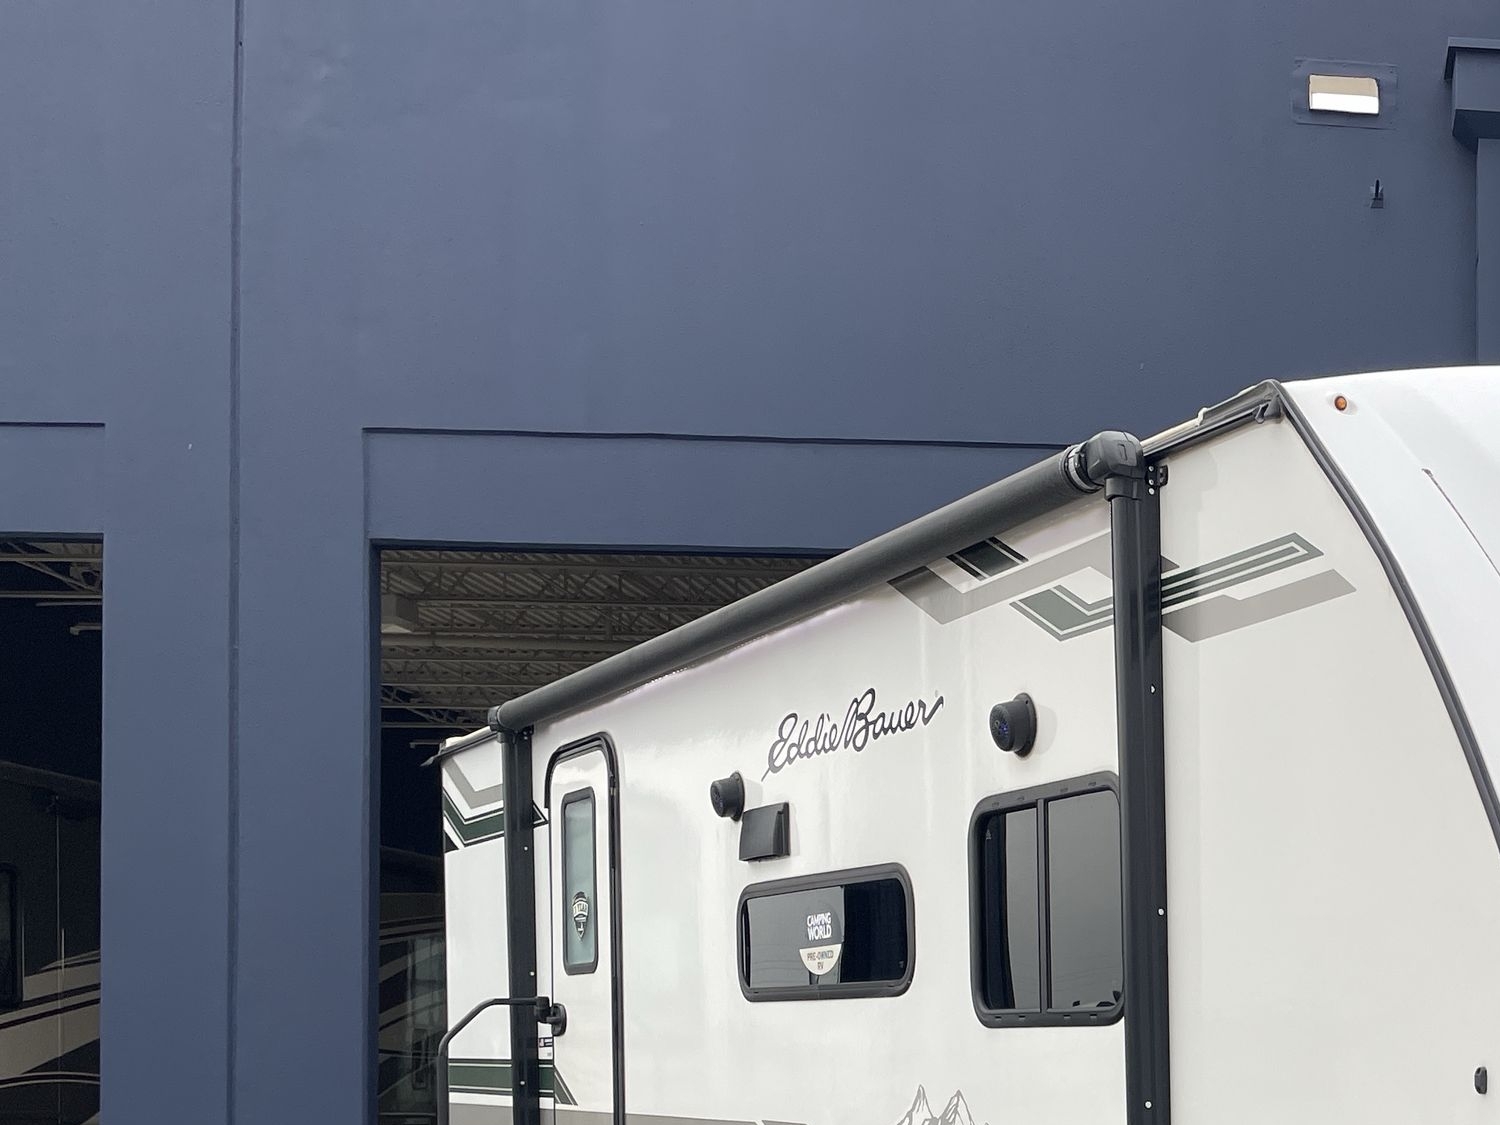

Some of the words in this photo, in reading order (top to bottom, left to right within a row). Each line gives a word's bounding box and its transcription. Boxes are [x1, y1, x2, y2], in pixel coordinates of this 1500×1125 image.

[761, 712, 844, 783] Eddie
[841, 687, 945, 752] Bauer
[806, 911, 832, 927] CAMPING
[807, 924, 832, 941] WORLD
